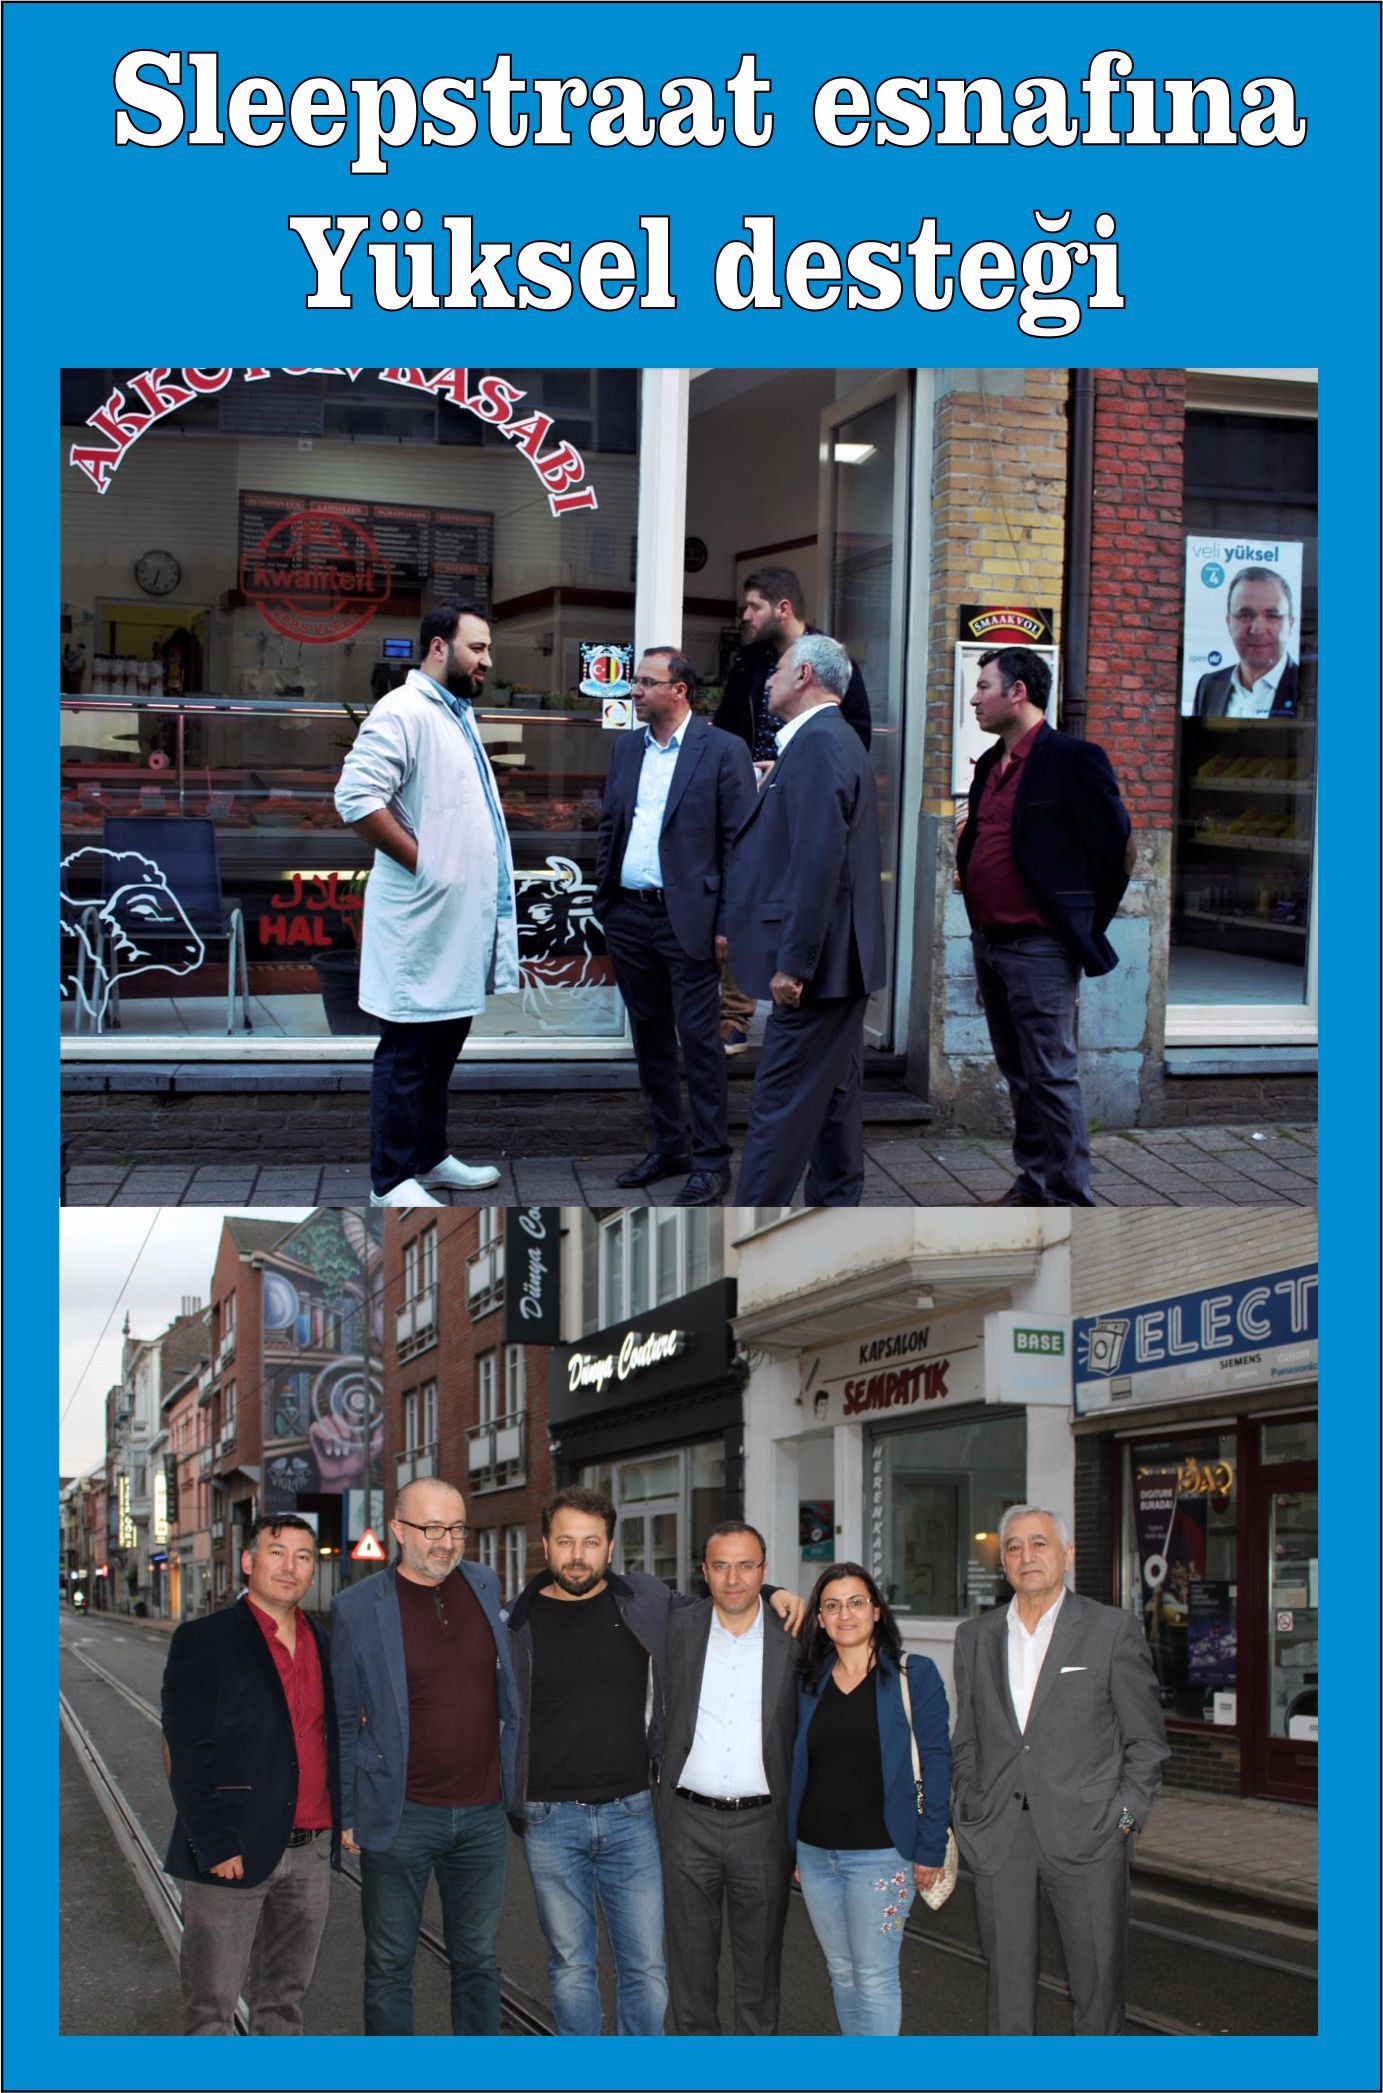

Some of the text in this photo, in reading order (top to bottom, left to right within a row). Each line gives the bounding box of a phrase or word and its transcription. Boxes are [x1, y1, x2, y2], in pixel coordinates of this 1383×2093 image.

[1192, 543, 1279, 563] veli yüksel
[254, 563, 375, 592] kwaliteit
[1209, 571, 1219, 585] 4
[973, 613, 1040, 634] SMAAKVOL
[519, 1246, 549, 1320] Dünya
[1135, 1273, 1318, 1364] ELECT
[858, 1326, 930, 1364] KAPSALON
[1016, 1332, 1061, 1352] BASE
[568, 1329, 677, 1393] Dünya Couture
[1219, 1353, 1262, 1370] SIEMENS
[1270, 1361, 1318, 1377] Panasonic
